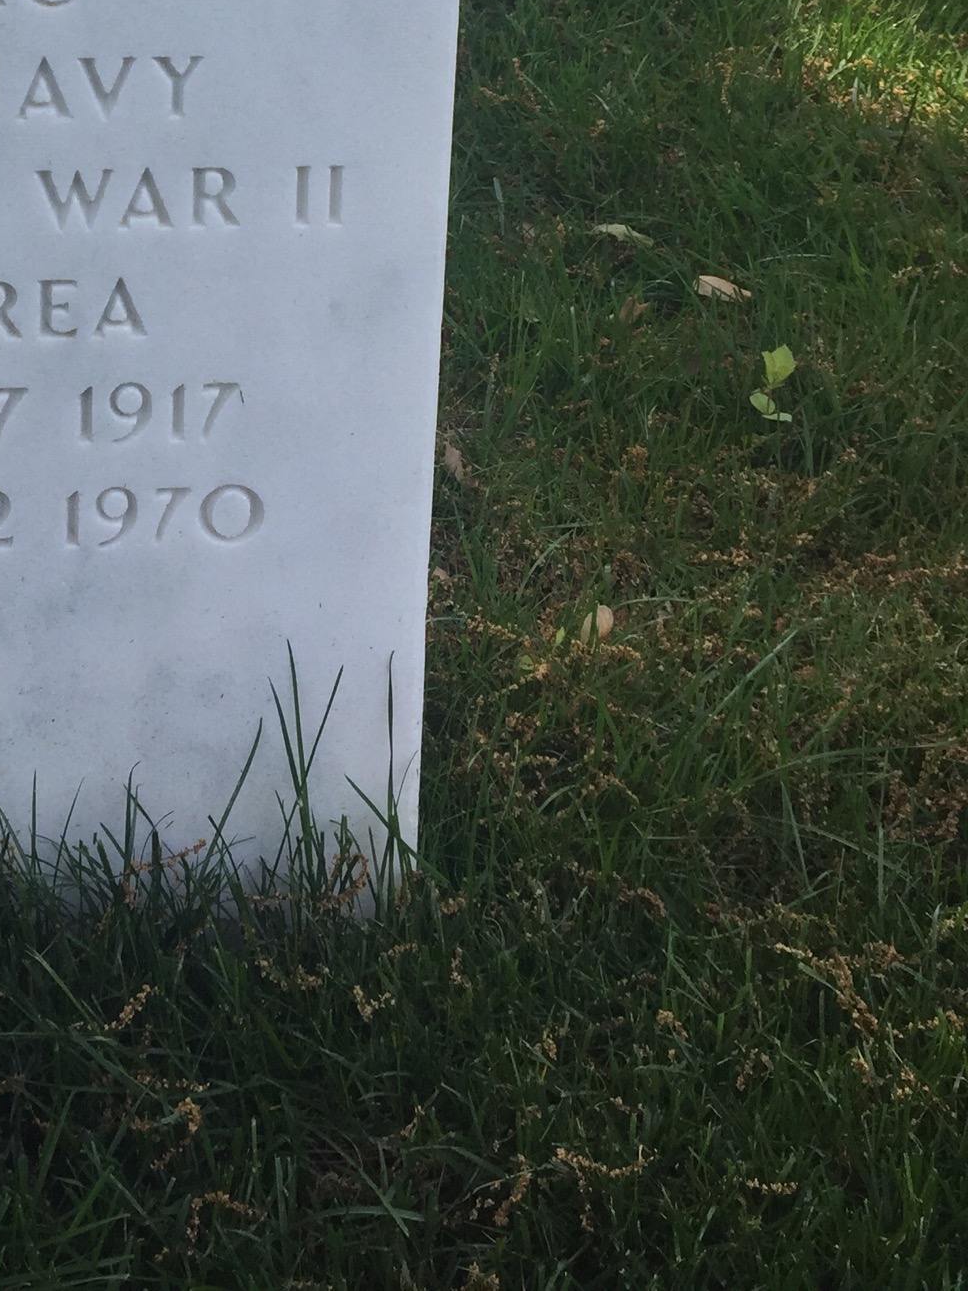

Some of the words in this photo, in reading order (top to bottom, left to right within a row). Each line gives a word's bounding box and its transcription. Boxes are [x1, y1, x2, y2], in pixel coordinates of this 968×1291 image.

[34, 167, 241, 232] WAR
[294, 165, 345, 227] II
[78, 382, 242, 444] 1917
[65, 484, 265, 549] 1970
